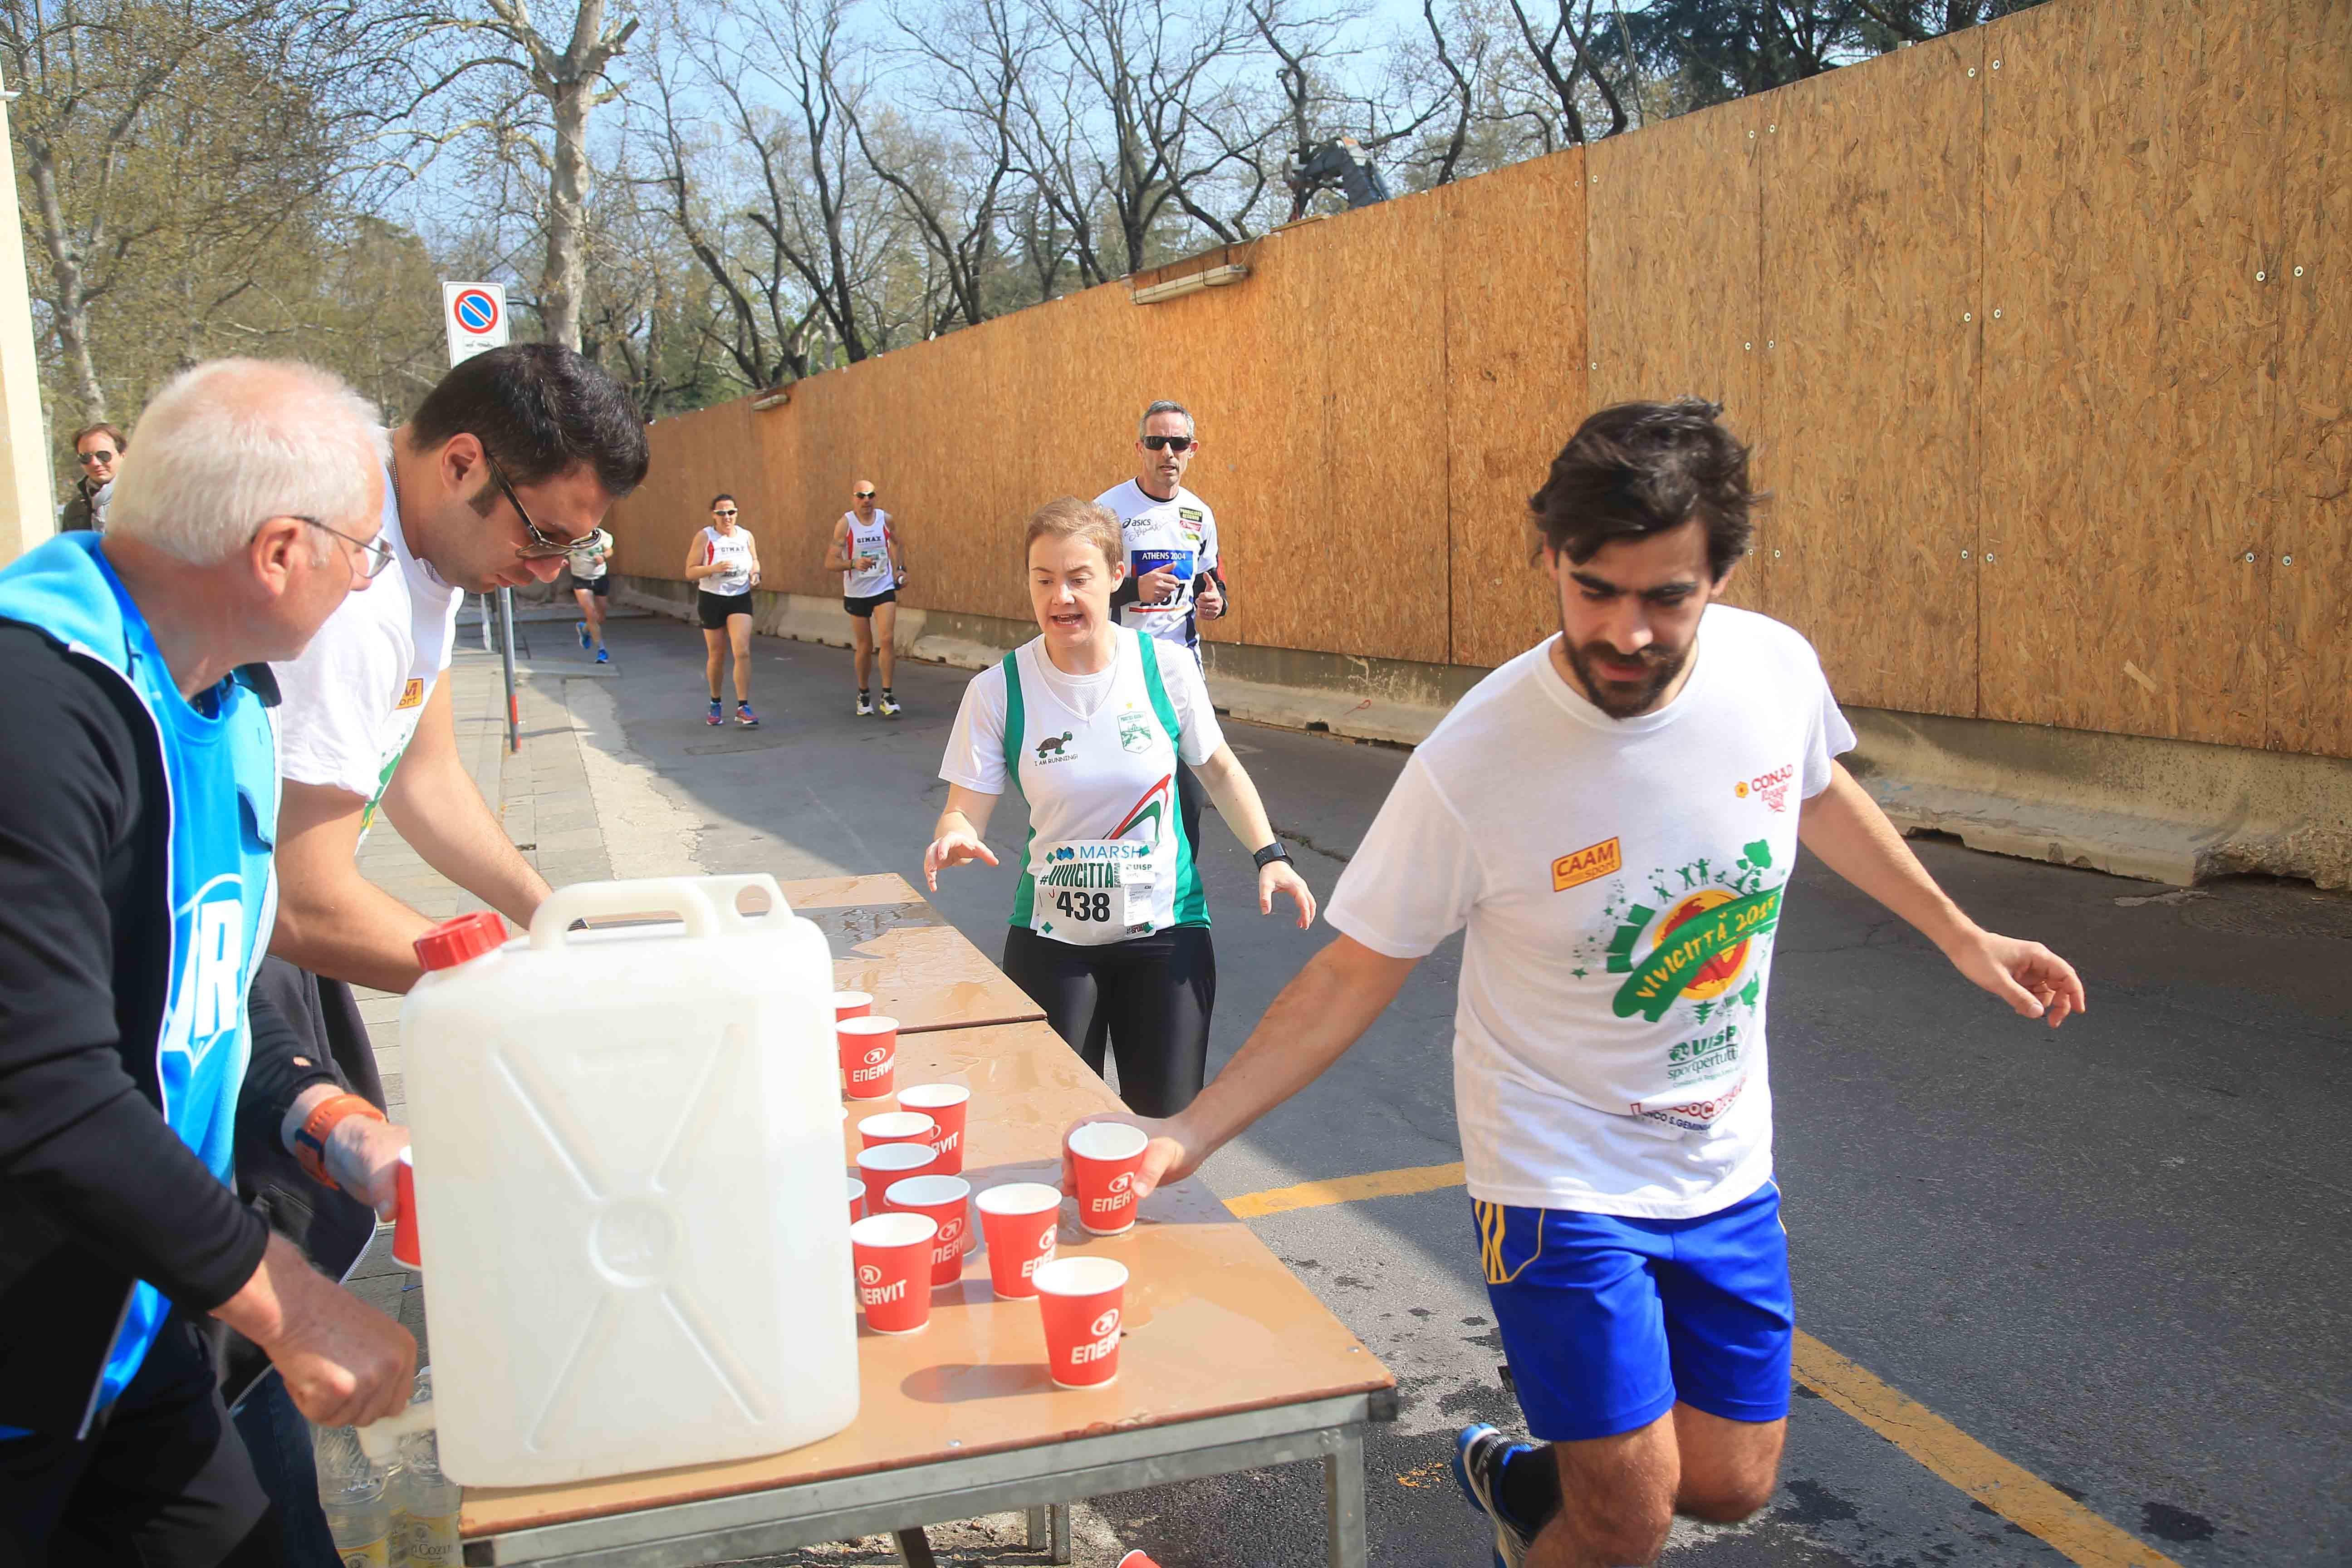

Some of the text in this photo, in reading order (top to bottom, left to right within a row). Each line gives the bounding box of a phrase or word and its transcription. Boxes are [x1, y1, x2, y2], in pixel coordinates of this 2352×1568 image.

[1132, 519, 1151, 527] asics
[1142, 552, 1186, 560] ATHENS 2004
[1048, 754, 1078, 764] RUNNING!
[1752, 764, 1793, 792] CONAD
[1080, 846, 1142, 859] MARSH
[1557, 843, 1613, 877] CAAM
[1585, 859, 1615, 878] sport
[1056, 891, 1110, 922] 438
[1692, 1025, 1736, 1056] UISP
[1091, 1190, 1134, 1213] ENER
